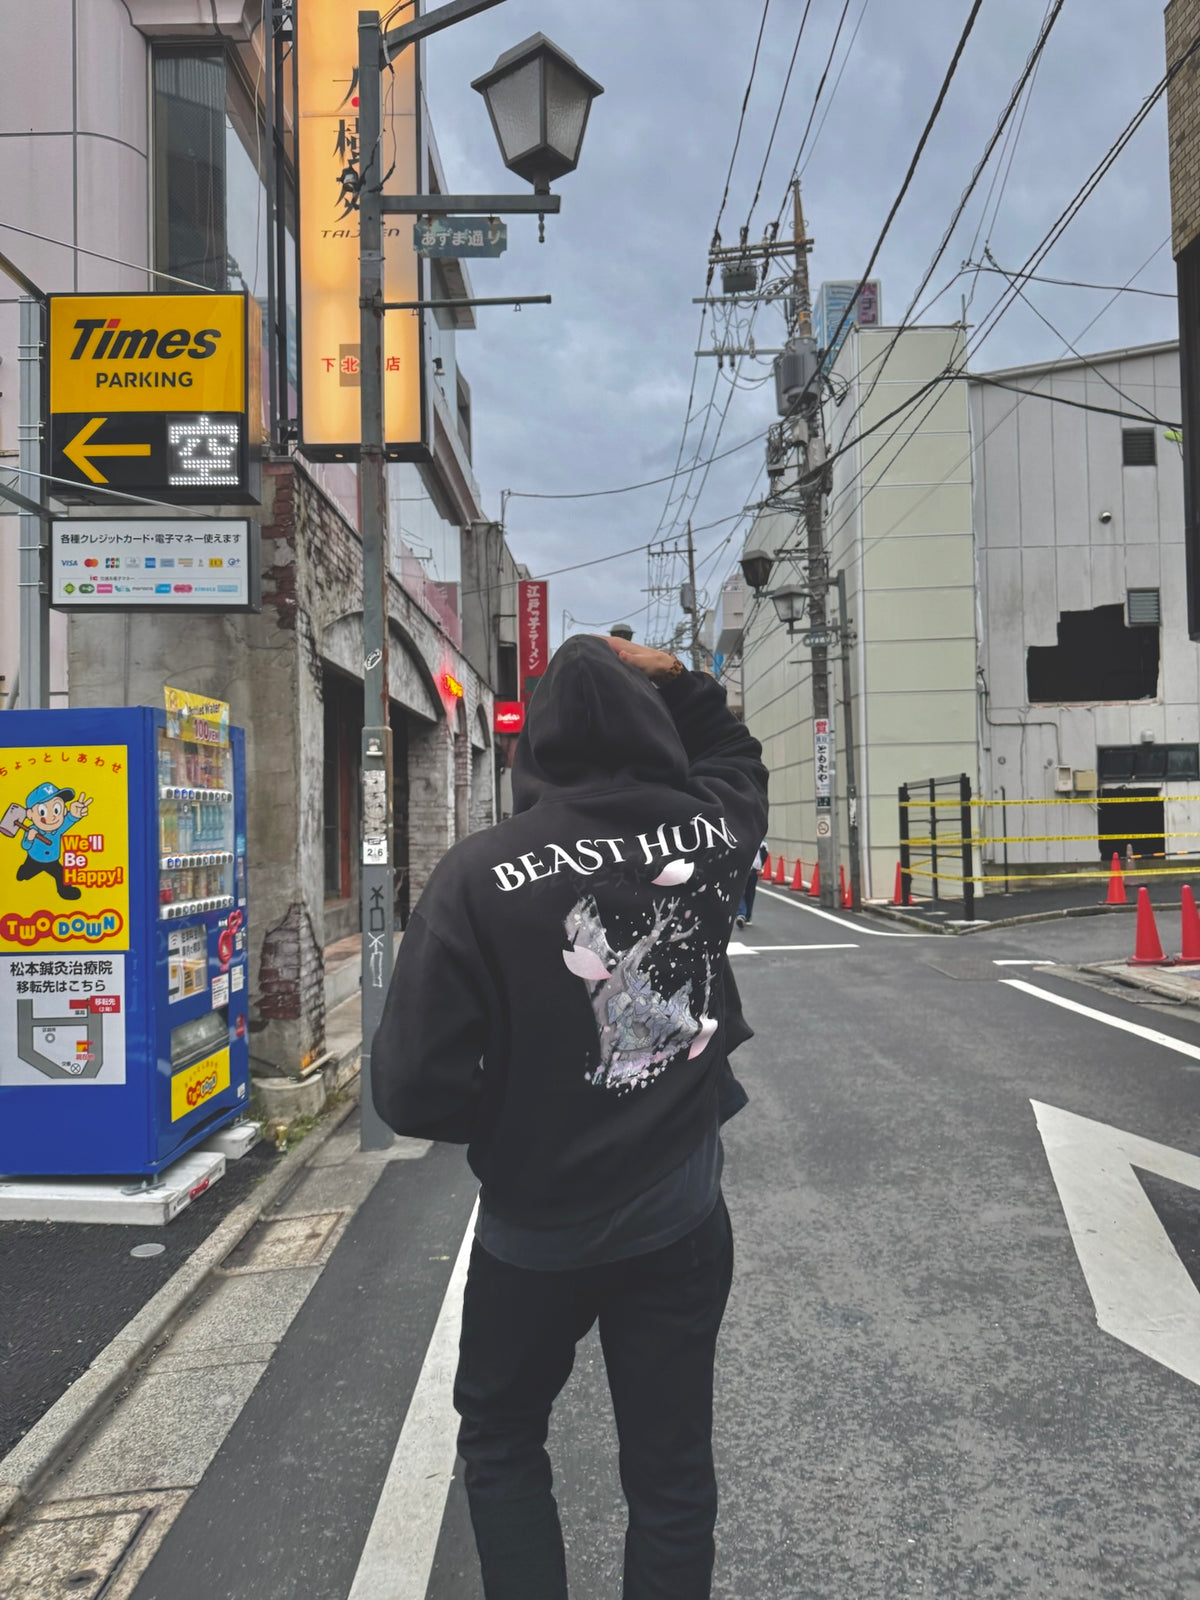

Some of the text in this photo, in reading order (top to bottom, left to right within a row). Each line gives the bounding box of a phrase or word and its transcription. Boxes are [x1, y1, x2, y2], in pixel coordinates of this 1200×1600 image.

[421, 227, 500, 247] あずま通り
[70, 318, 221, 360] Times
[321, 355, 401, 373] 下北店
[96, 371, 194, 388] PARKING
[169, 416, 239, 486] 空
[61, 559, 78, 567] VISA
[0, 751, 122, 777] ちょっとしあわせ
[63, 835, 103, 852] We'll
[491, 812, 739, 892] BEAST HUN
[63, 852, 87, 867] Be
[64, 867, 123, 886] Happy!
[6, 915, 116, 940] TWO DOWN
[10, 960, 113, 977] 松本鍼灸治療院
[16, 979, 106, 993] 移転先はこちら
